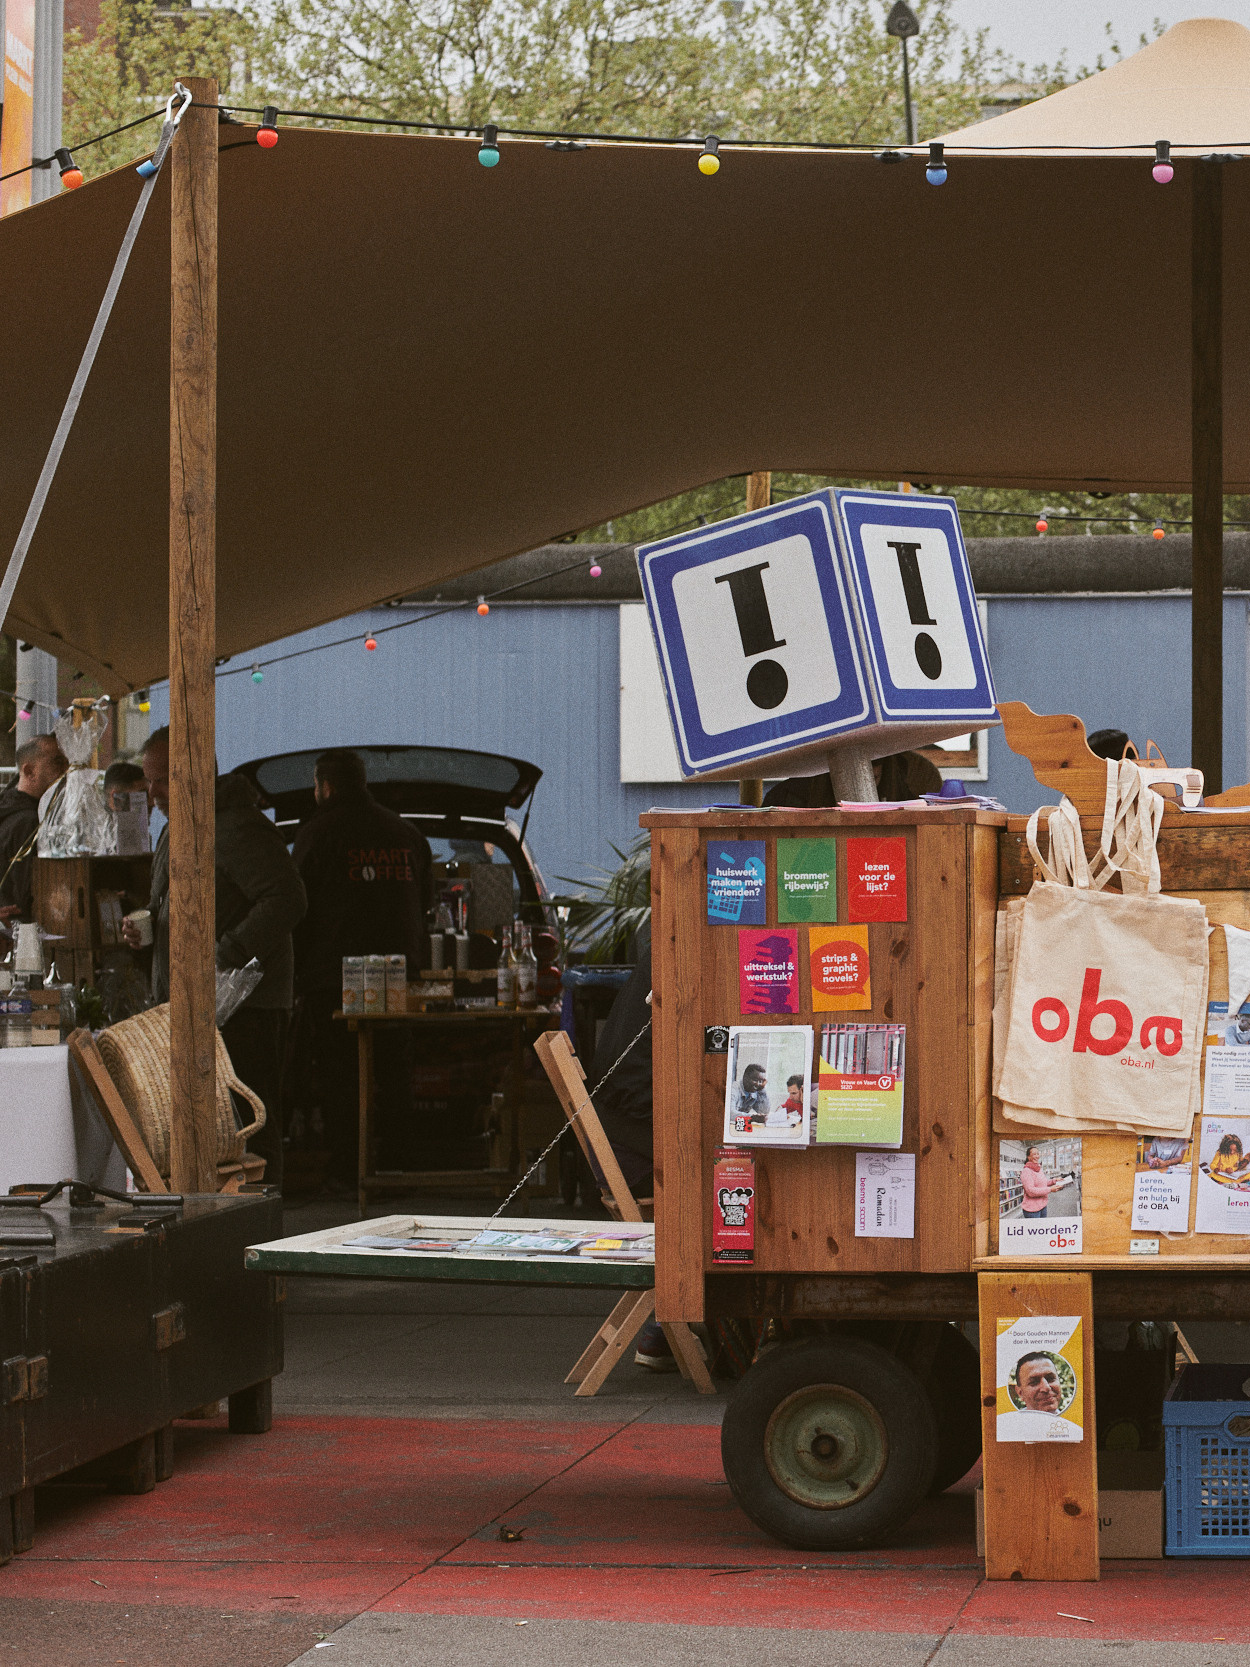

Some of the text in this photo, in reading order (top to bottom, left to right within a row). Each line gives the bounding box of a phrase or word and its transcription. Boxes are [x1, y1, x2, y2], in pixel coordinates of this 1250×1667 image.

[348, 849, 412, 864] SMART
[864, 862, 889, 871] lezen
[715, 867, 758, 877] huiswerk
[784, 871, 830, 880] brommer-
[858, 872, 895, 881] voor de
[711, 877, 763, 886] maken met
[784, 881, 829, 891] rijbewijs?
[866, 881, 889, 892] lijst?
[714, 887, 760, 897] vrienden?
[821, 953, 858, 965] strips &
[744, 962, 795, 971] uittreksel &
[823, 963, 858, 975] graphic
[746, 972, 793, 981] werkstuk?
[823, 973, 859, 983] novels?
[1032, 968, 1183, 1057] oba
[1120, 1056, 1155, 1070] oba.nl
[1140, 1177, 1165, 1185] Leren,
[1150, 1194, 1168, 1203] hulp
[1170, 1195, 1180, 1204] bij
[1227, 1196, 1249, 1207] leren
[876, 1187, 887, 1227] Ramadan
[1007, 1224, 1078, 1236] Lid worden?
[1049, 1235, 1075, 1248] oba
